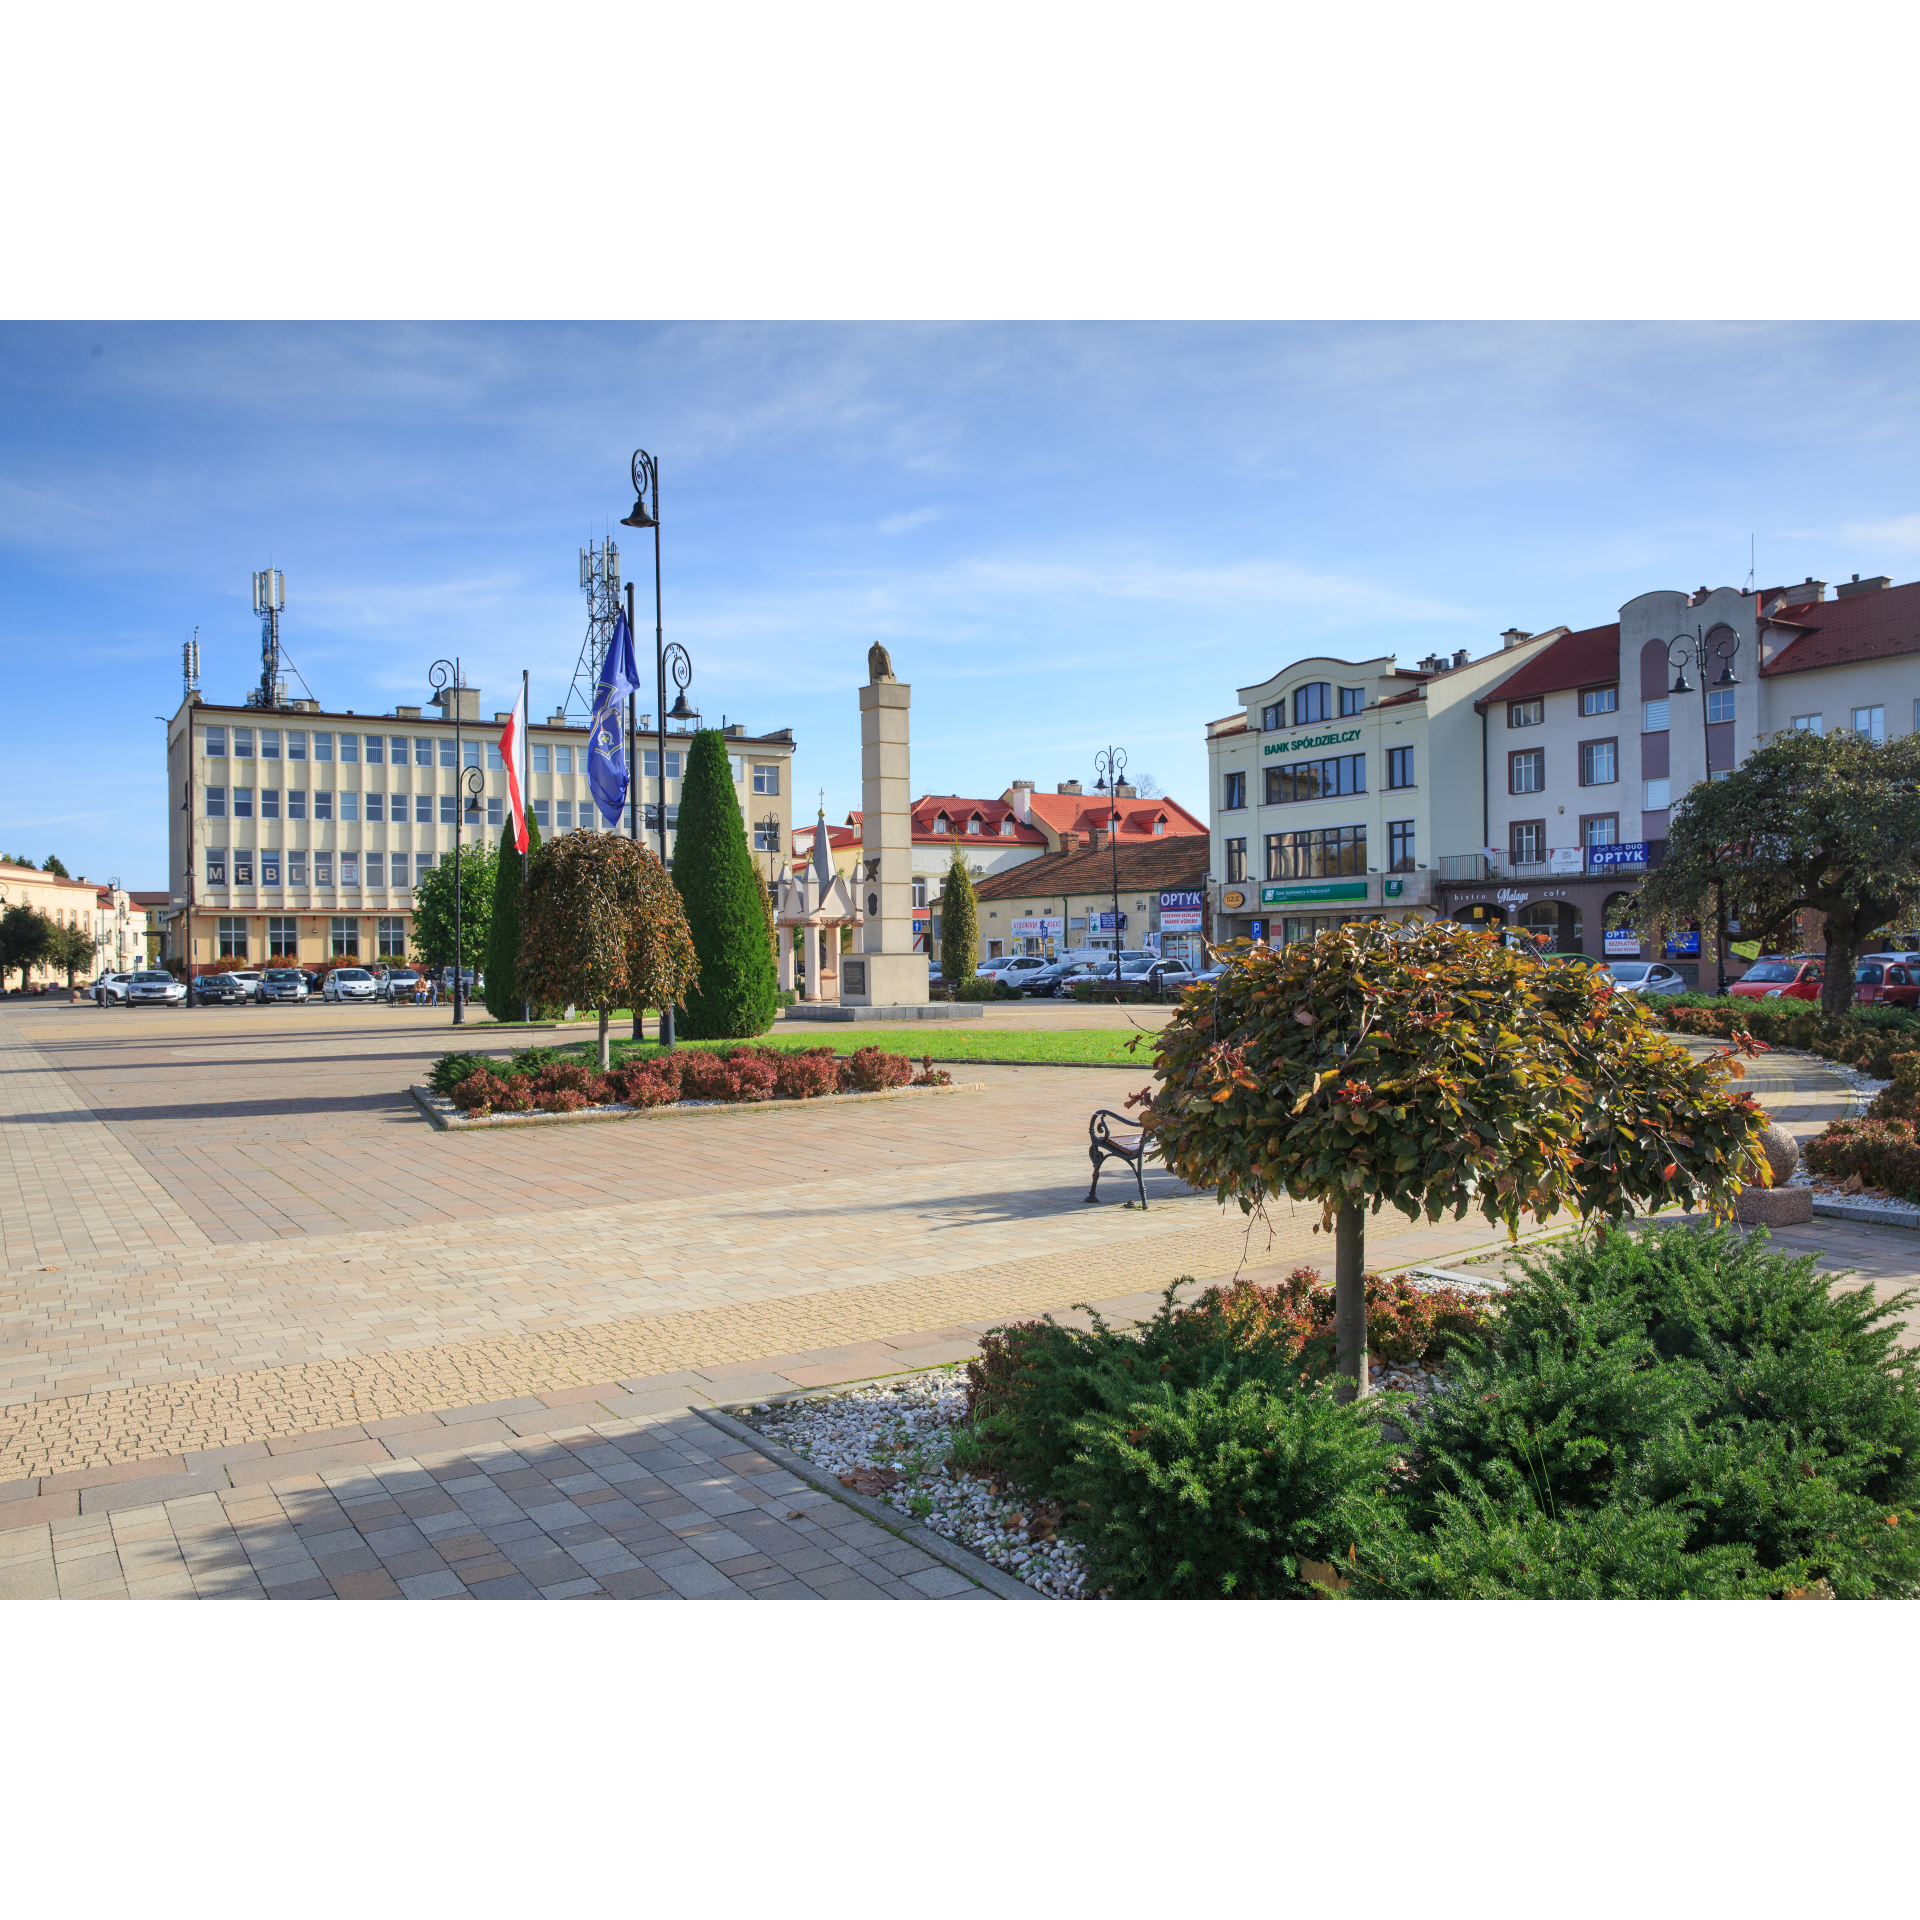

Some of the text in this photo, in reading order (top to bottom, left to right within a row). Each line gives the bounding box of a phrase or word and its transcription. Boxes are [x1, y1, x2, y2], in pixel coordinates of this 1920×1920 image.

[1264, 729, 1361, 756] BANK SPÓŁDZIELCZY
[1593, 851, 1643, 863] OPTYK
[209, 867, 328, 880] MEBLE
[1160, 892, 1200, 905] OPTYK
[1496, 888, 1529, 903] Malaga
[1543, 889, 1566, 897] cafe
[1254, 922, 1259, 934] P
